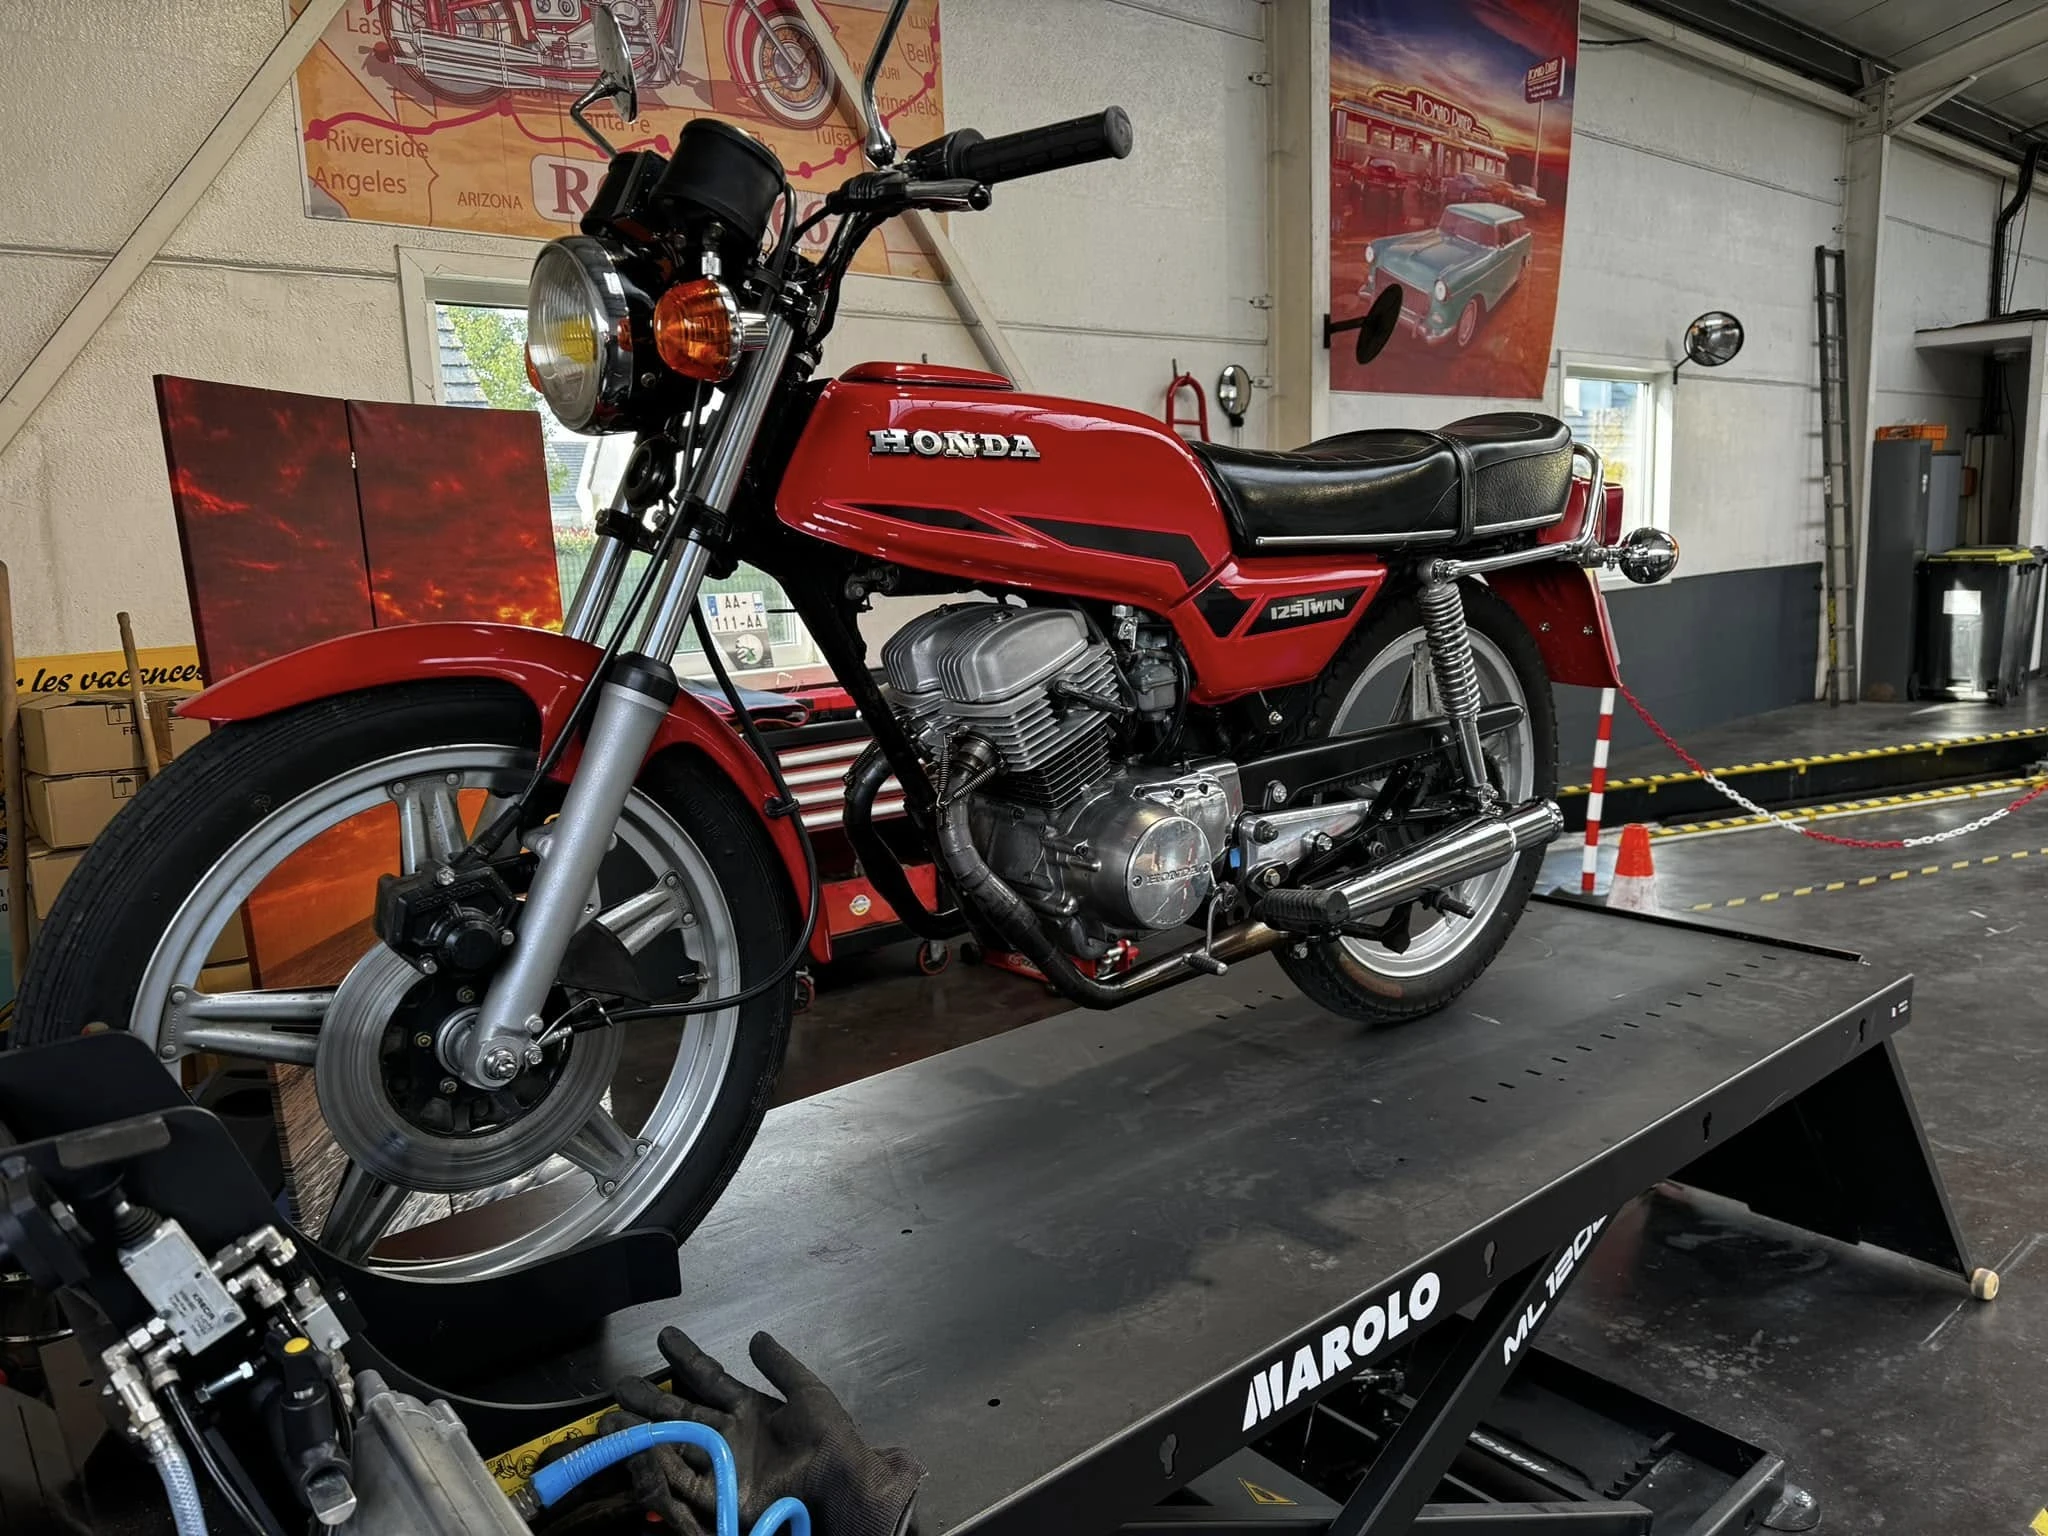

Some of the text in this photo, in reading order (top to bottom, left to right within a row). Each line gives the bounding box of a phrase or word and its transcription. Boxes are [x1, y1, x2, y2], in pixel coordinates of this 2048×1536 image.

[346, 10, 382, 36] Las
[875, 92, 938, 118] ringfield
[1416, 93, 1450, 124] NOMAD
[583, 111, 625, 132] anta
[326, 128, 429, 159] Riverside
[816, 127, 852, 147] Tulsa
[313, 166, 408, 197] Angeles
[457, 191, 523, 210] ARIZONA
[868, 428, 1041, 460] HONDA
[715, 614, 762, 631] 111-AA
[32, 668, 73, 693] les
[1504, 1300, 1547, 1365] ML
[1242, 1272, 1440, 1432] MAROLO
